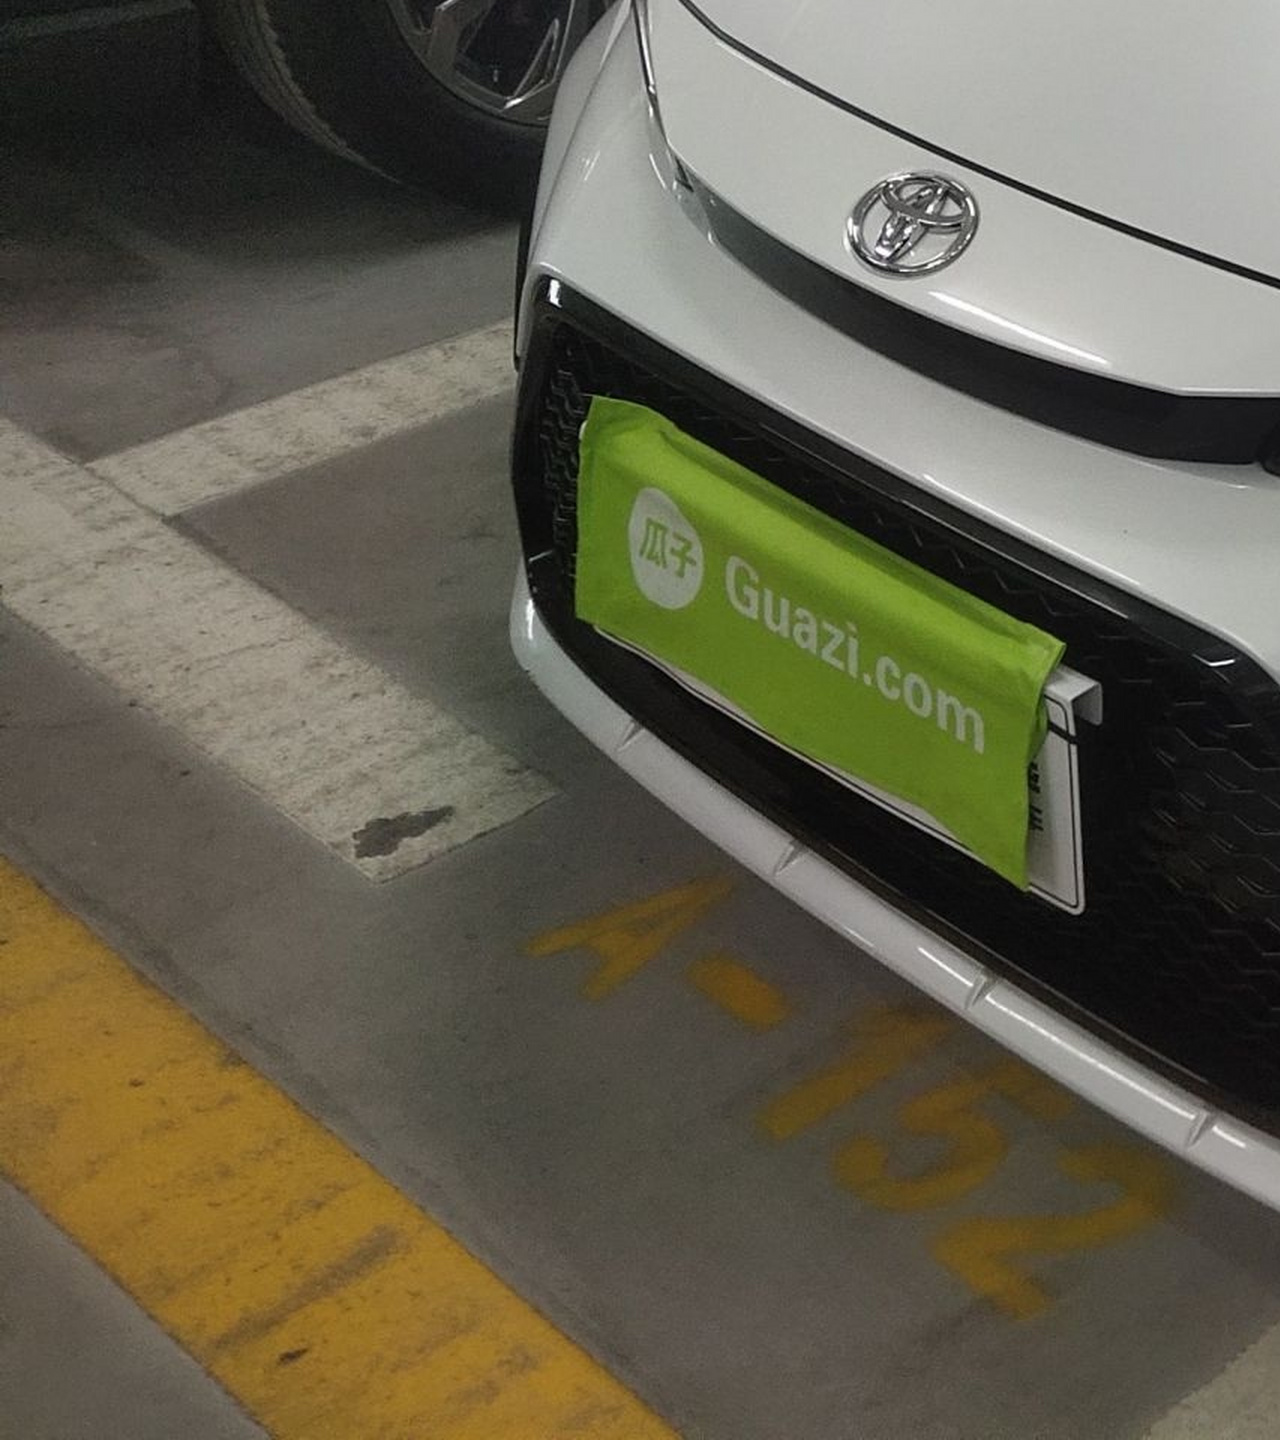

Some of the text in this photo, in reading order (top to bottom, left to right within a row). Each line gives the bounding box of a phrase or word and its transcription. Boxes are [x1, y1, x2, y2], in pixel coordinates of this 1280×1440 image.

[638, 515, 698, 583] 瓜子
[724, 553, 987, 756] Guazi.com
[520, 870, 1180, 1324] A-152
